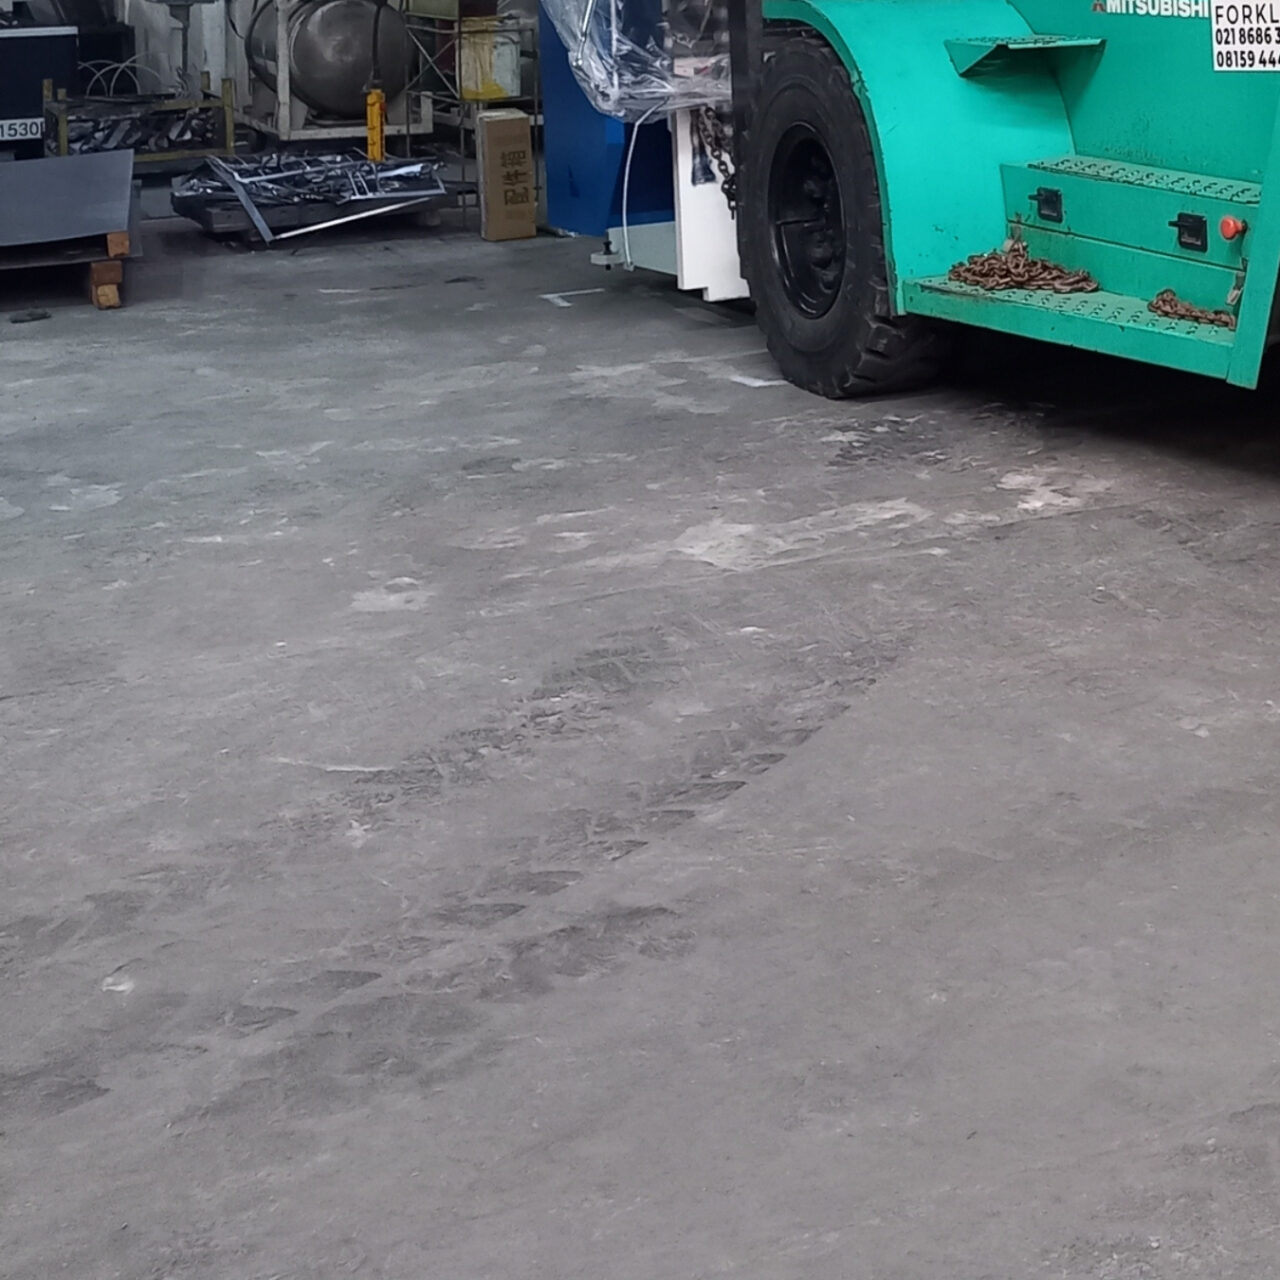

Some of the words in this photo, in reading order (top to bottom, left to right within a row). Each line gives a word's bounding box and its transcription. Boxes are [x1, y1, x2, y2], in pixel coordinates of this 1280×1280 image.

[1215, 28, 1236, 45] 021
[1238, 26, 1272, 45] 8686
[1216, 50, 1255, 68] 08159
[500, 149, 530, 207] 配件箱
